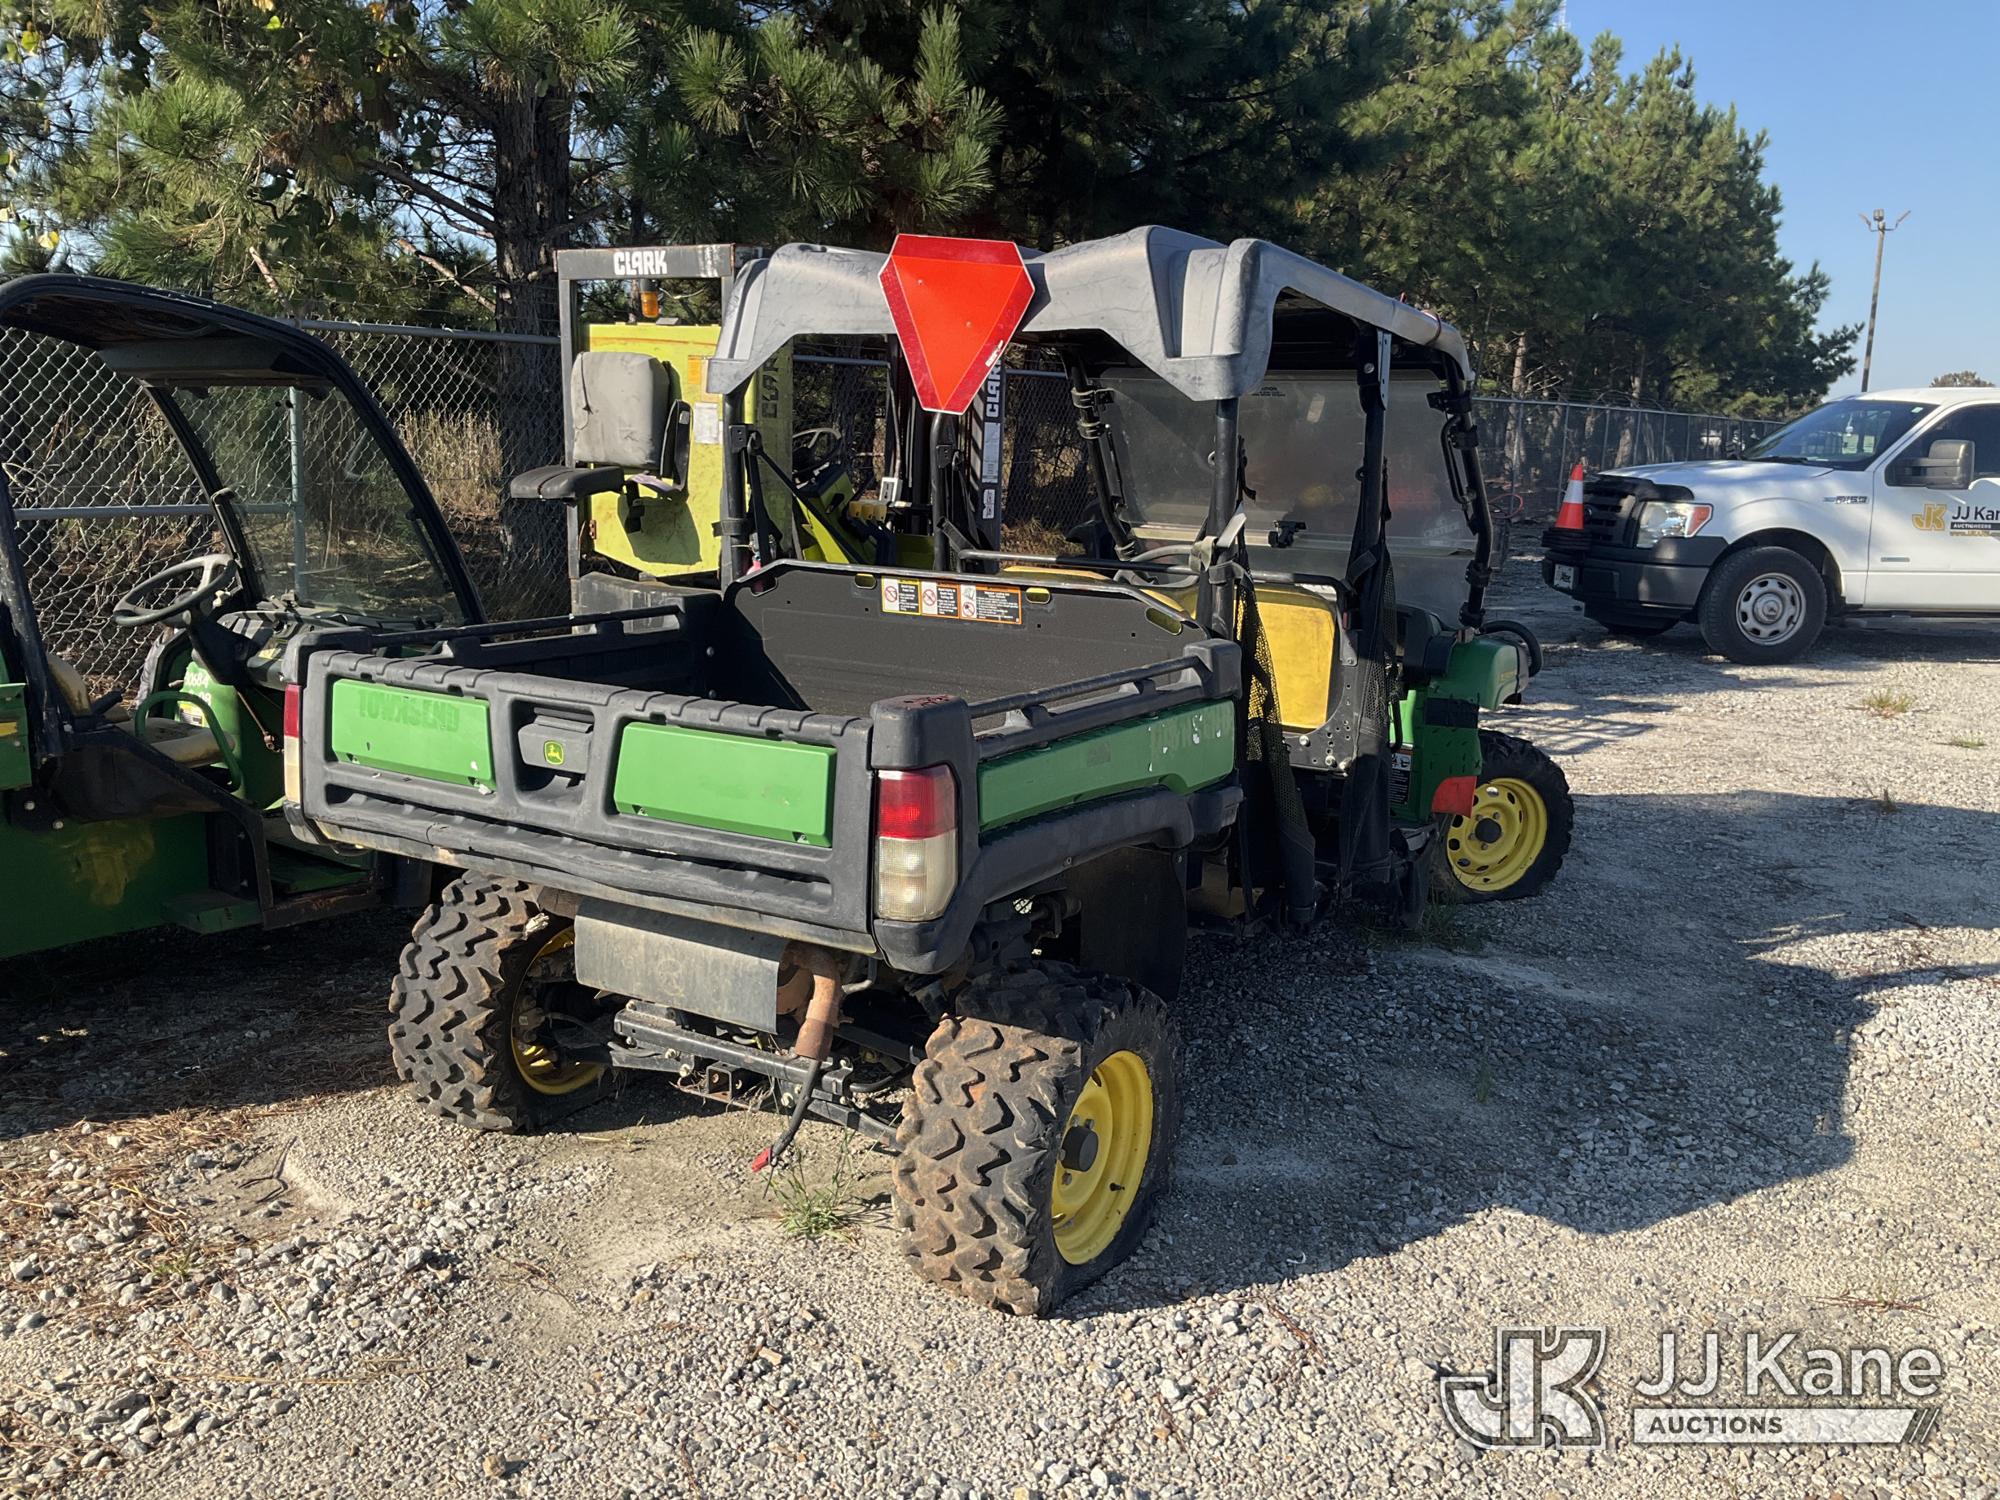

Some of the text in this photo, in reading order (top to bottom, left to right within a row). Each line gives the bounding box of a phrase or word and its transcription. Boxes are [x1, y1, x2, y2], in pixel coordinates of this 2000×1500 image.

[613, 249, 668, 276] CLARK
[761, 357, 779, 419] CLAR
[985, 357, 1001, 418] CLAR
[1952, 506, 1970, 520] JJ
